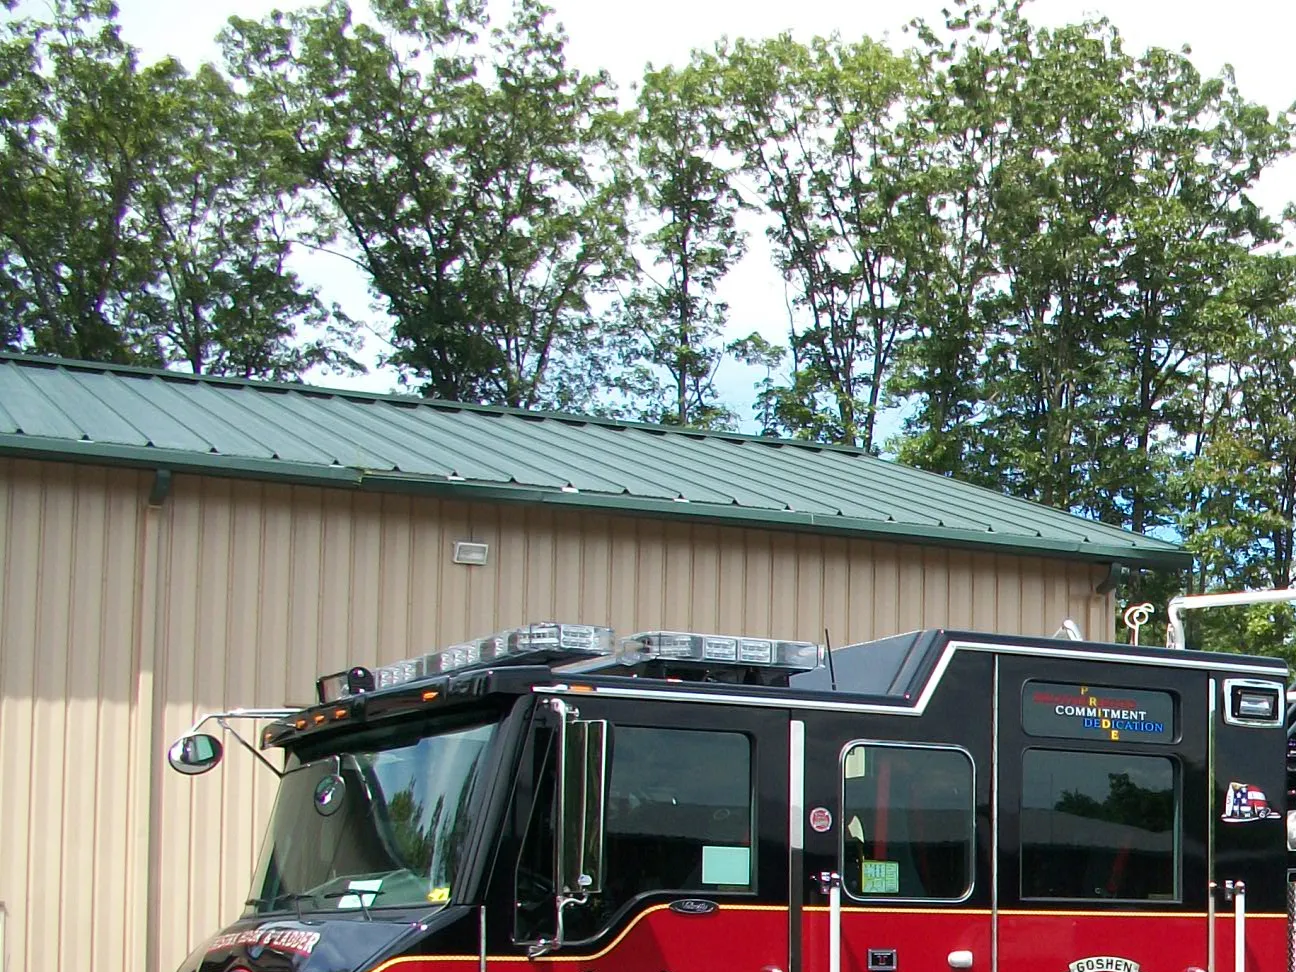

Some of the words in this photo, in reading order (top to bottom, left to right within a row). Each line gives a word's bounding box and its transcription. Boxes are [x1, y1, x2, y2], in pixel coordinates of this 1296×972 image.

[1055, 705, 1147, 721] COMMITMENT
[1083, 718, 1164, 732] DEDICATION
[276, 930, 320, 954] LADDER
